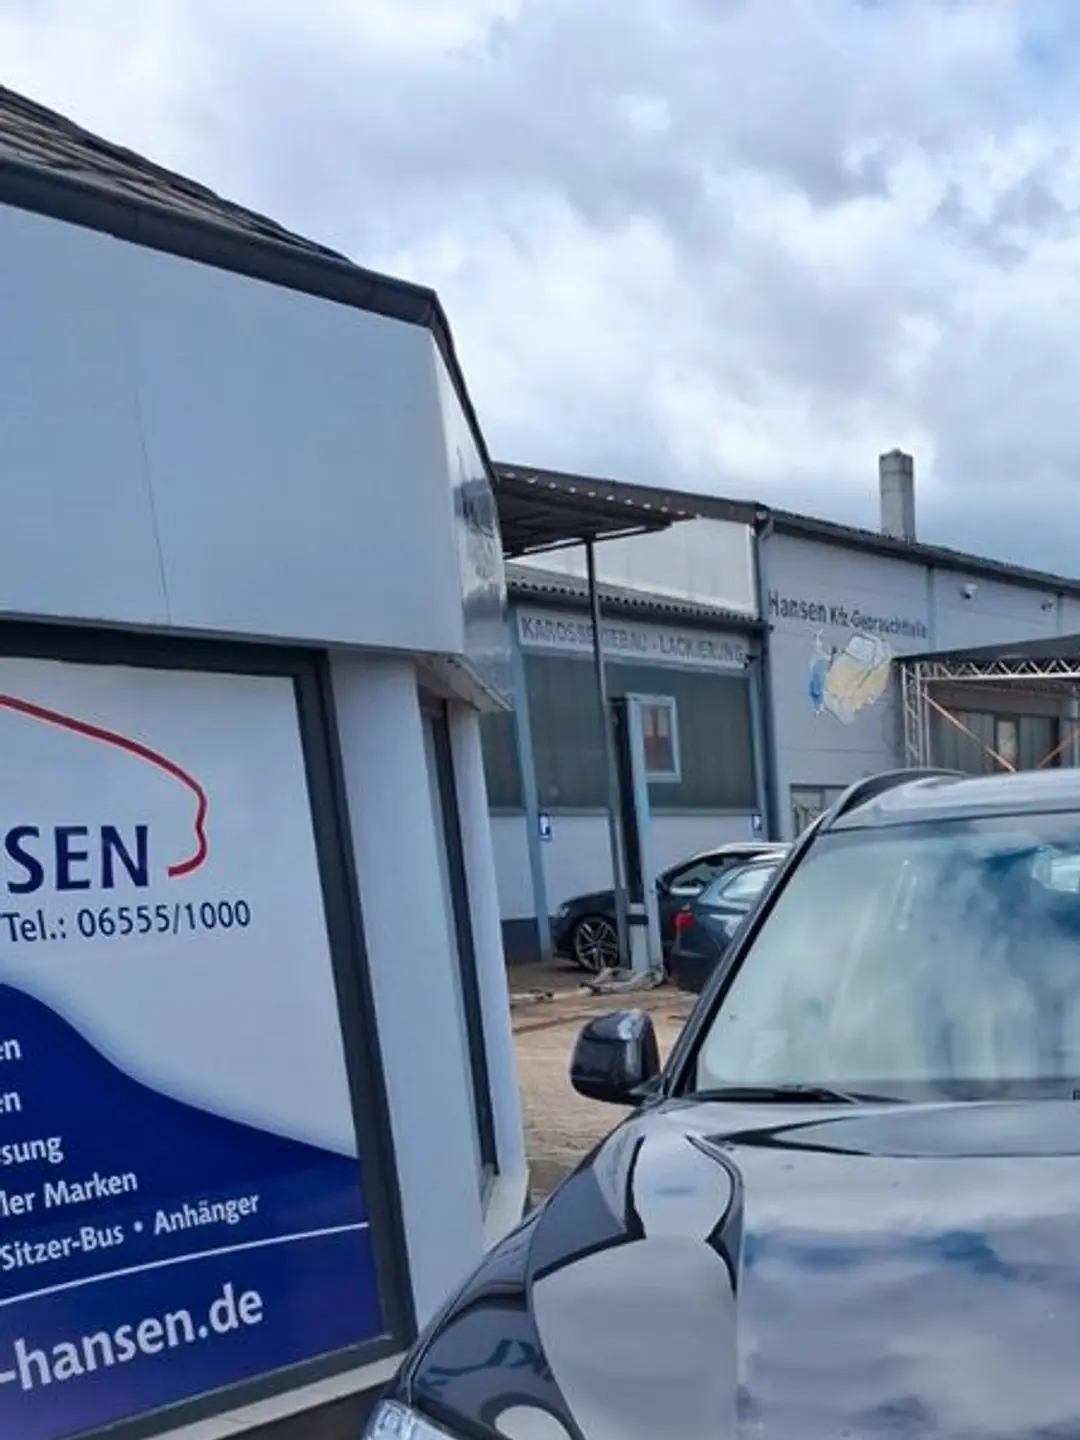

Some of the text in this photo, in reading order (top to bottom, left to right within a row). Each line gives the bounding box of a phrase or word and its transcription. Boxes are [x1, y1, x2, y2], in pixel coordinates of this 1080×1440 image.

[767, 588, 827, 625] Hansen
[4, 824, 150, 894] SEN
[1, 900, 251, 942] Tel.: 06555/1000
[0, 1136, 64, 1165] sung
[44, 1171, 138, 1209] Marken
[1, 1194, 260, 1270] Sitzer-Bus Anhänger
[0, 1282, 263, 1390] -hansen.de
